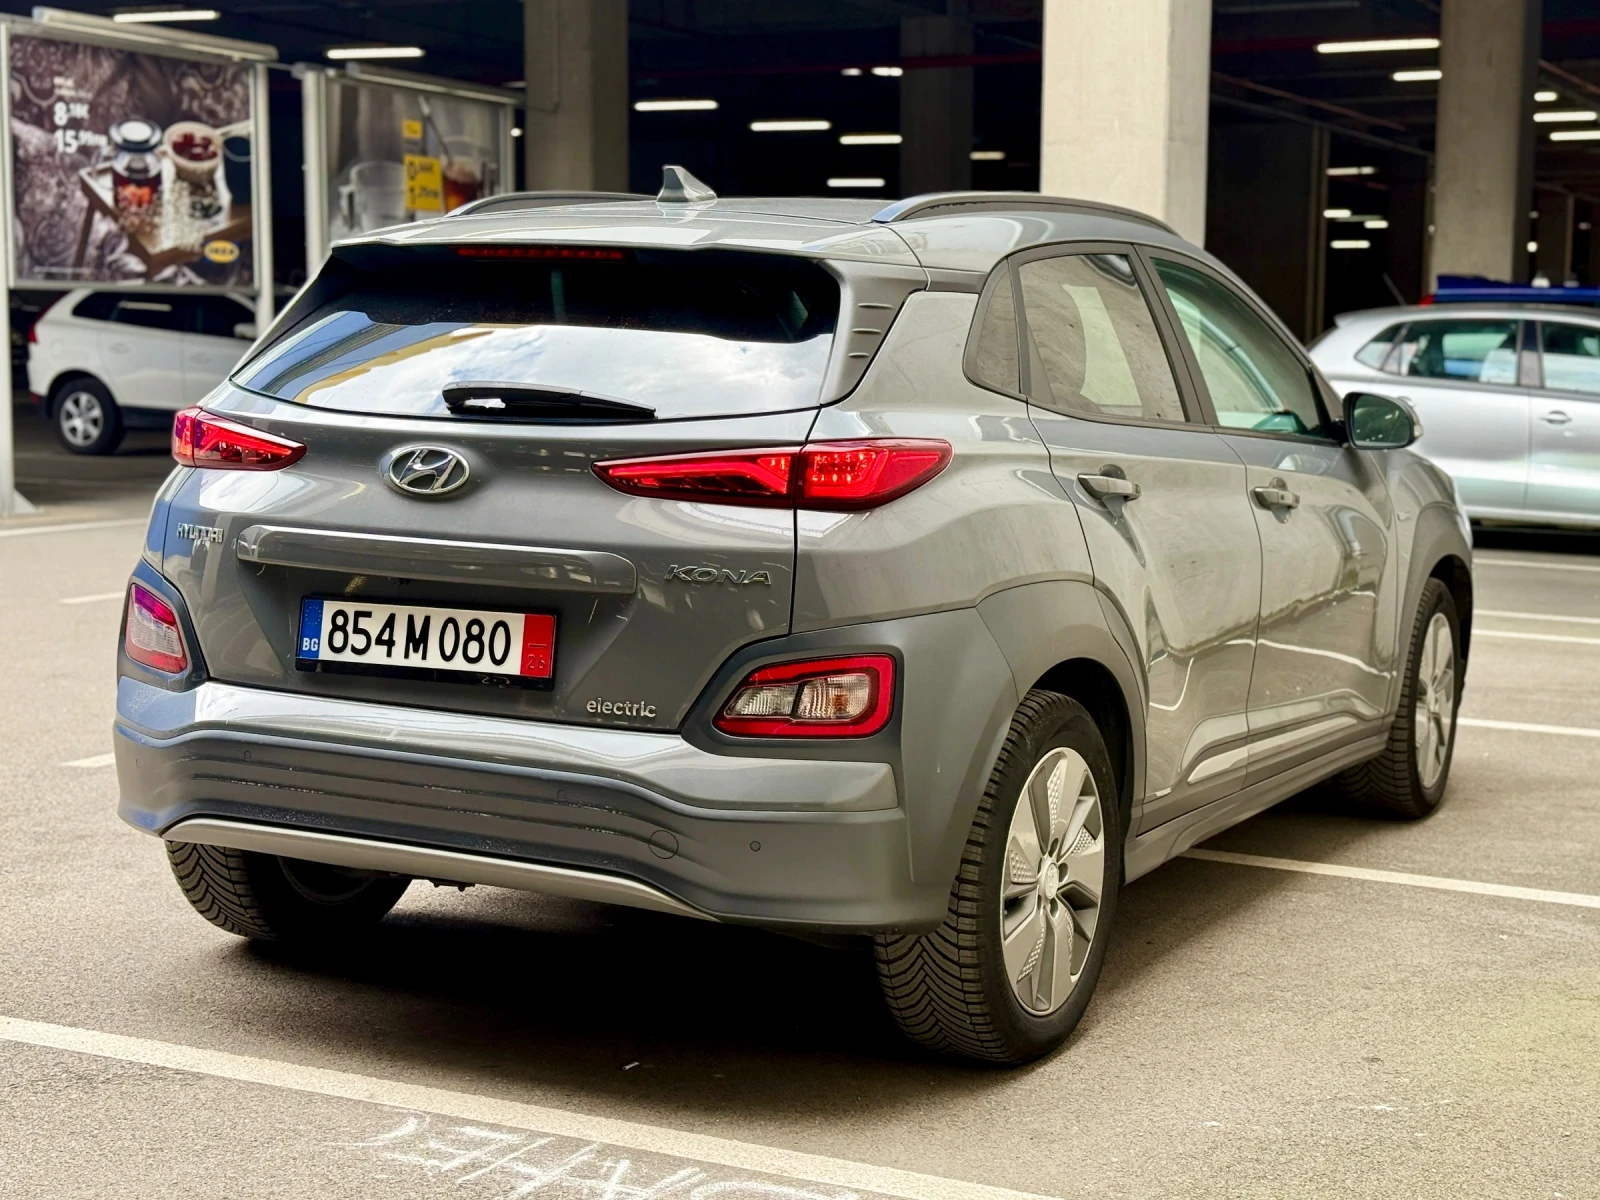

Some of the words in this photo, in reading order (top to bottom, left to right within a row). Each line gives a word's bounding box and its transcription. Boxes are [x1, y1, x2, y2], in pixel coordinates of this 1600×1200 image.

[664, 564, 772, 585] KONA
[302, 637, 319, 652] BG
[527, 653, 546, 670] 26
[586, 697, 657, 718] electric
